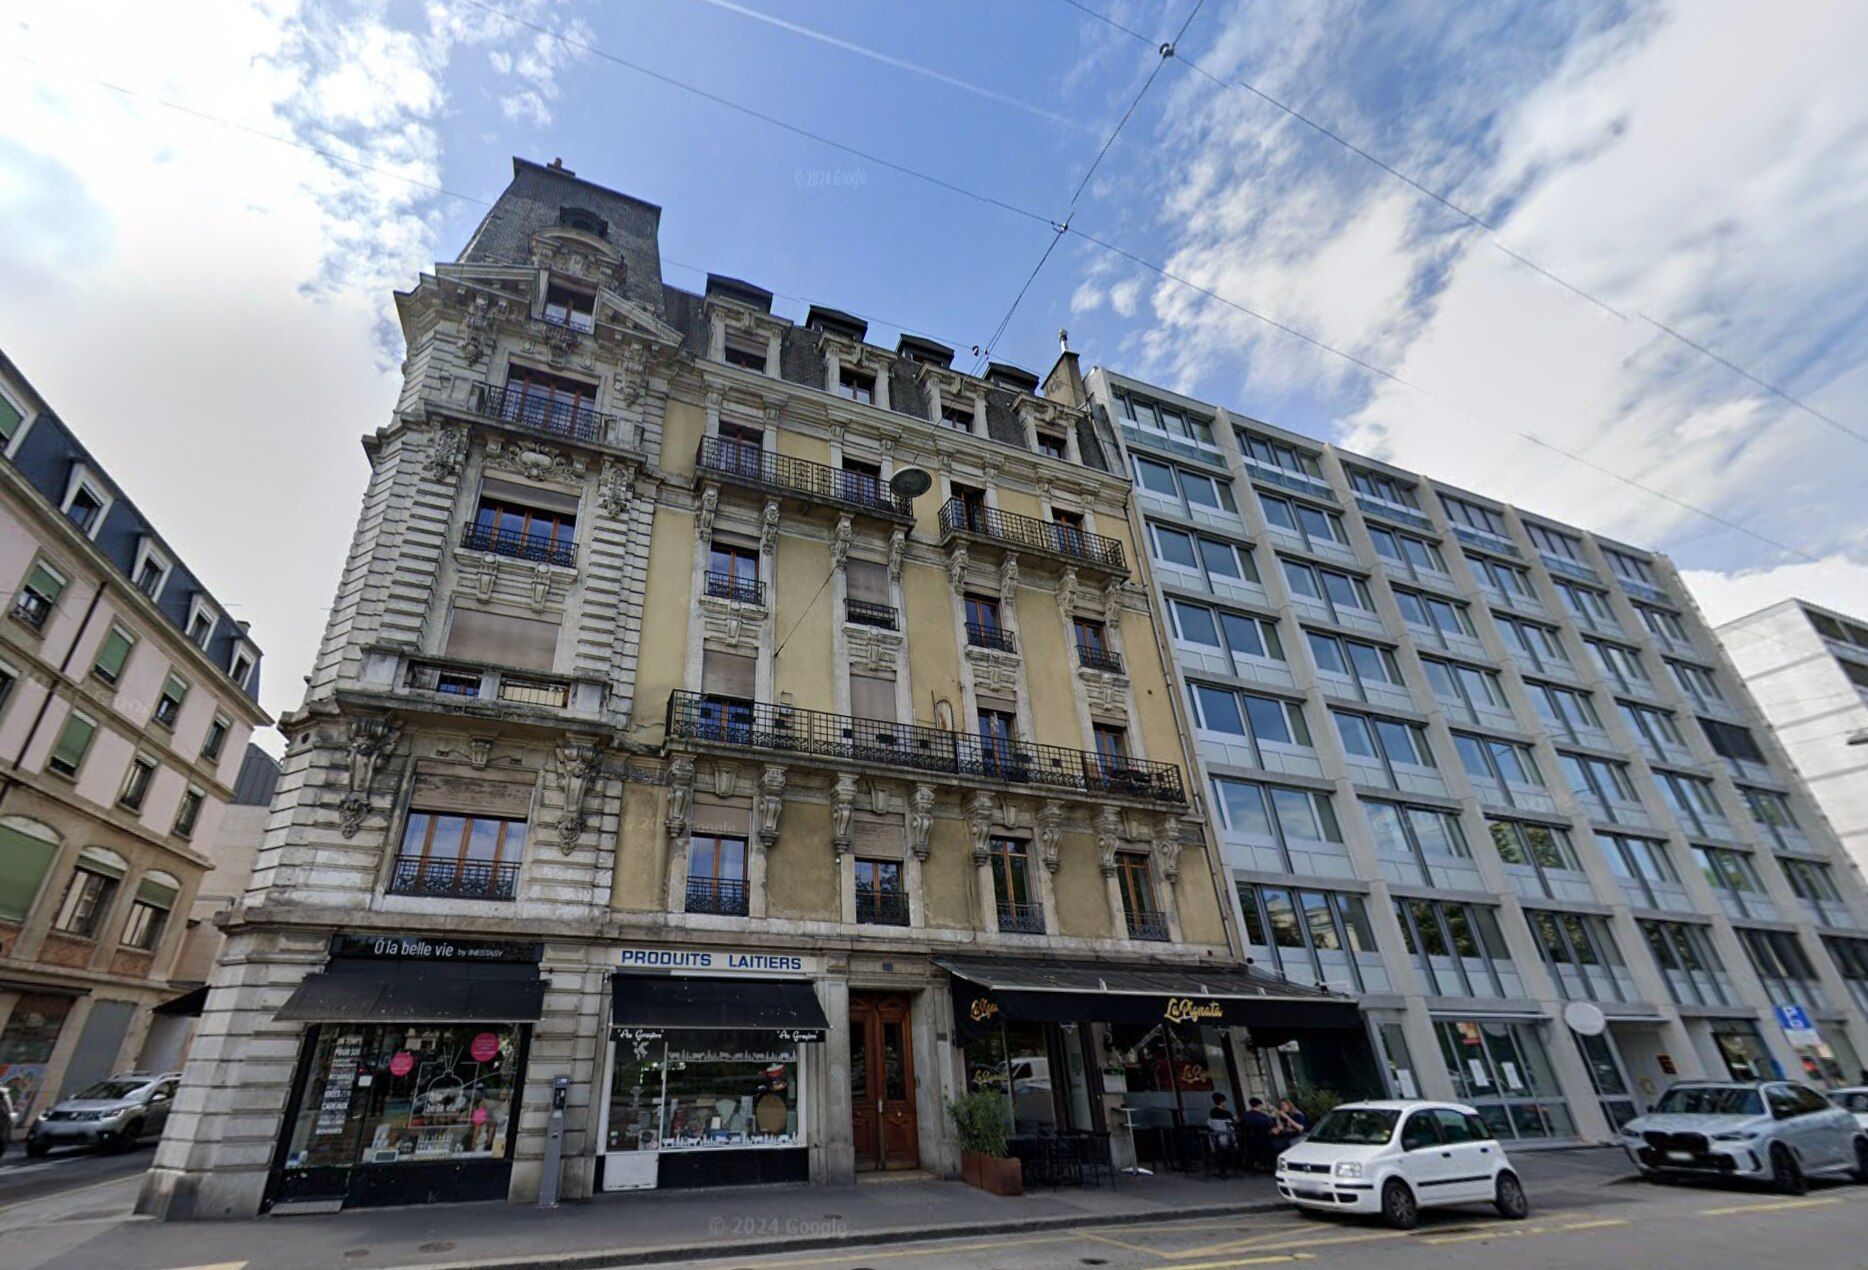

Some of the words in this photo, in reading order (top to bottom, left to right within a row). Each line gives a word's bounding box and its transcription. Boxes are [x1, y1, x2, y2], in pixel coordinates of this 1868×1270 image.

[401, 940, 432, 956] belle
[435, 942, 454, 957] vie
[621, 950, 712, 966] PRODUITS
[728, 954, 802, 970] LAITIERS
